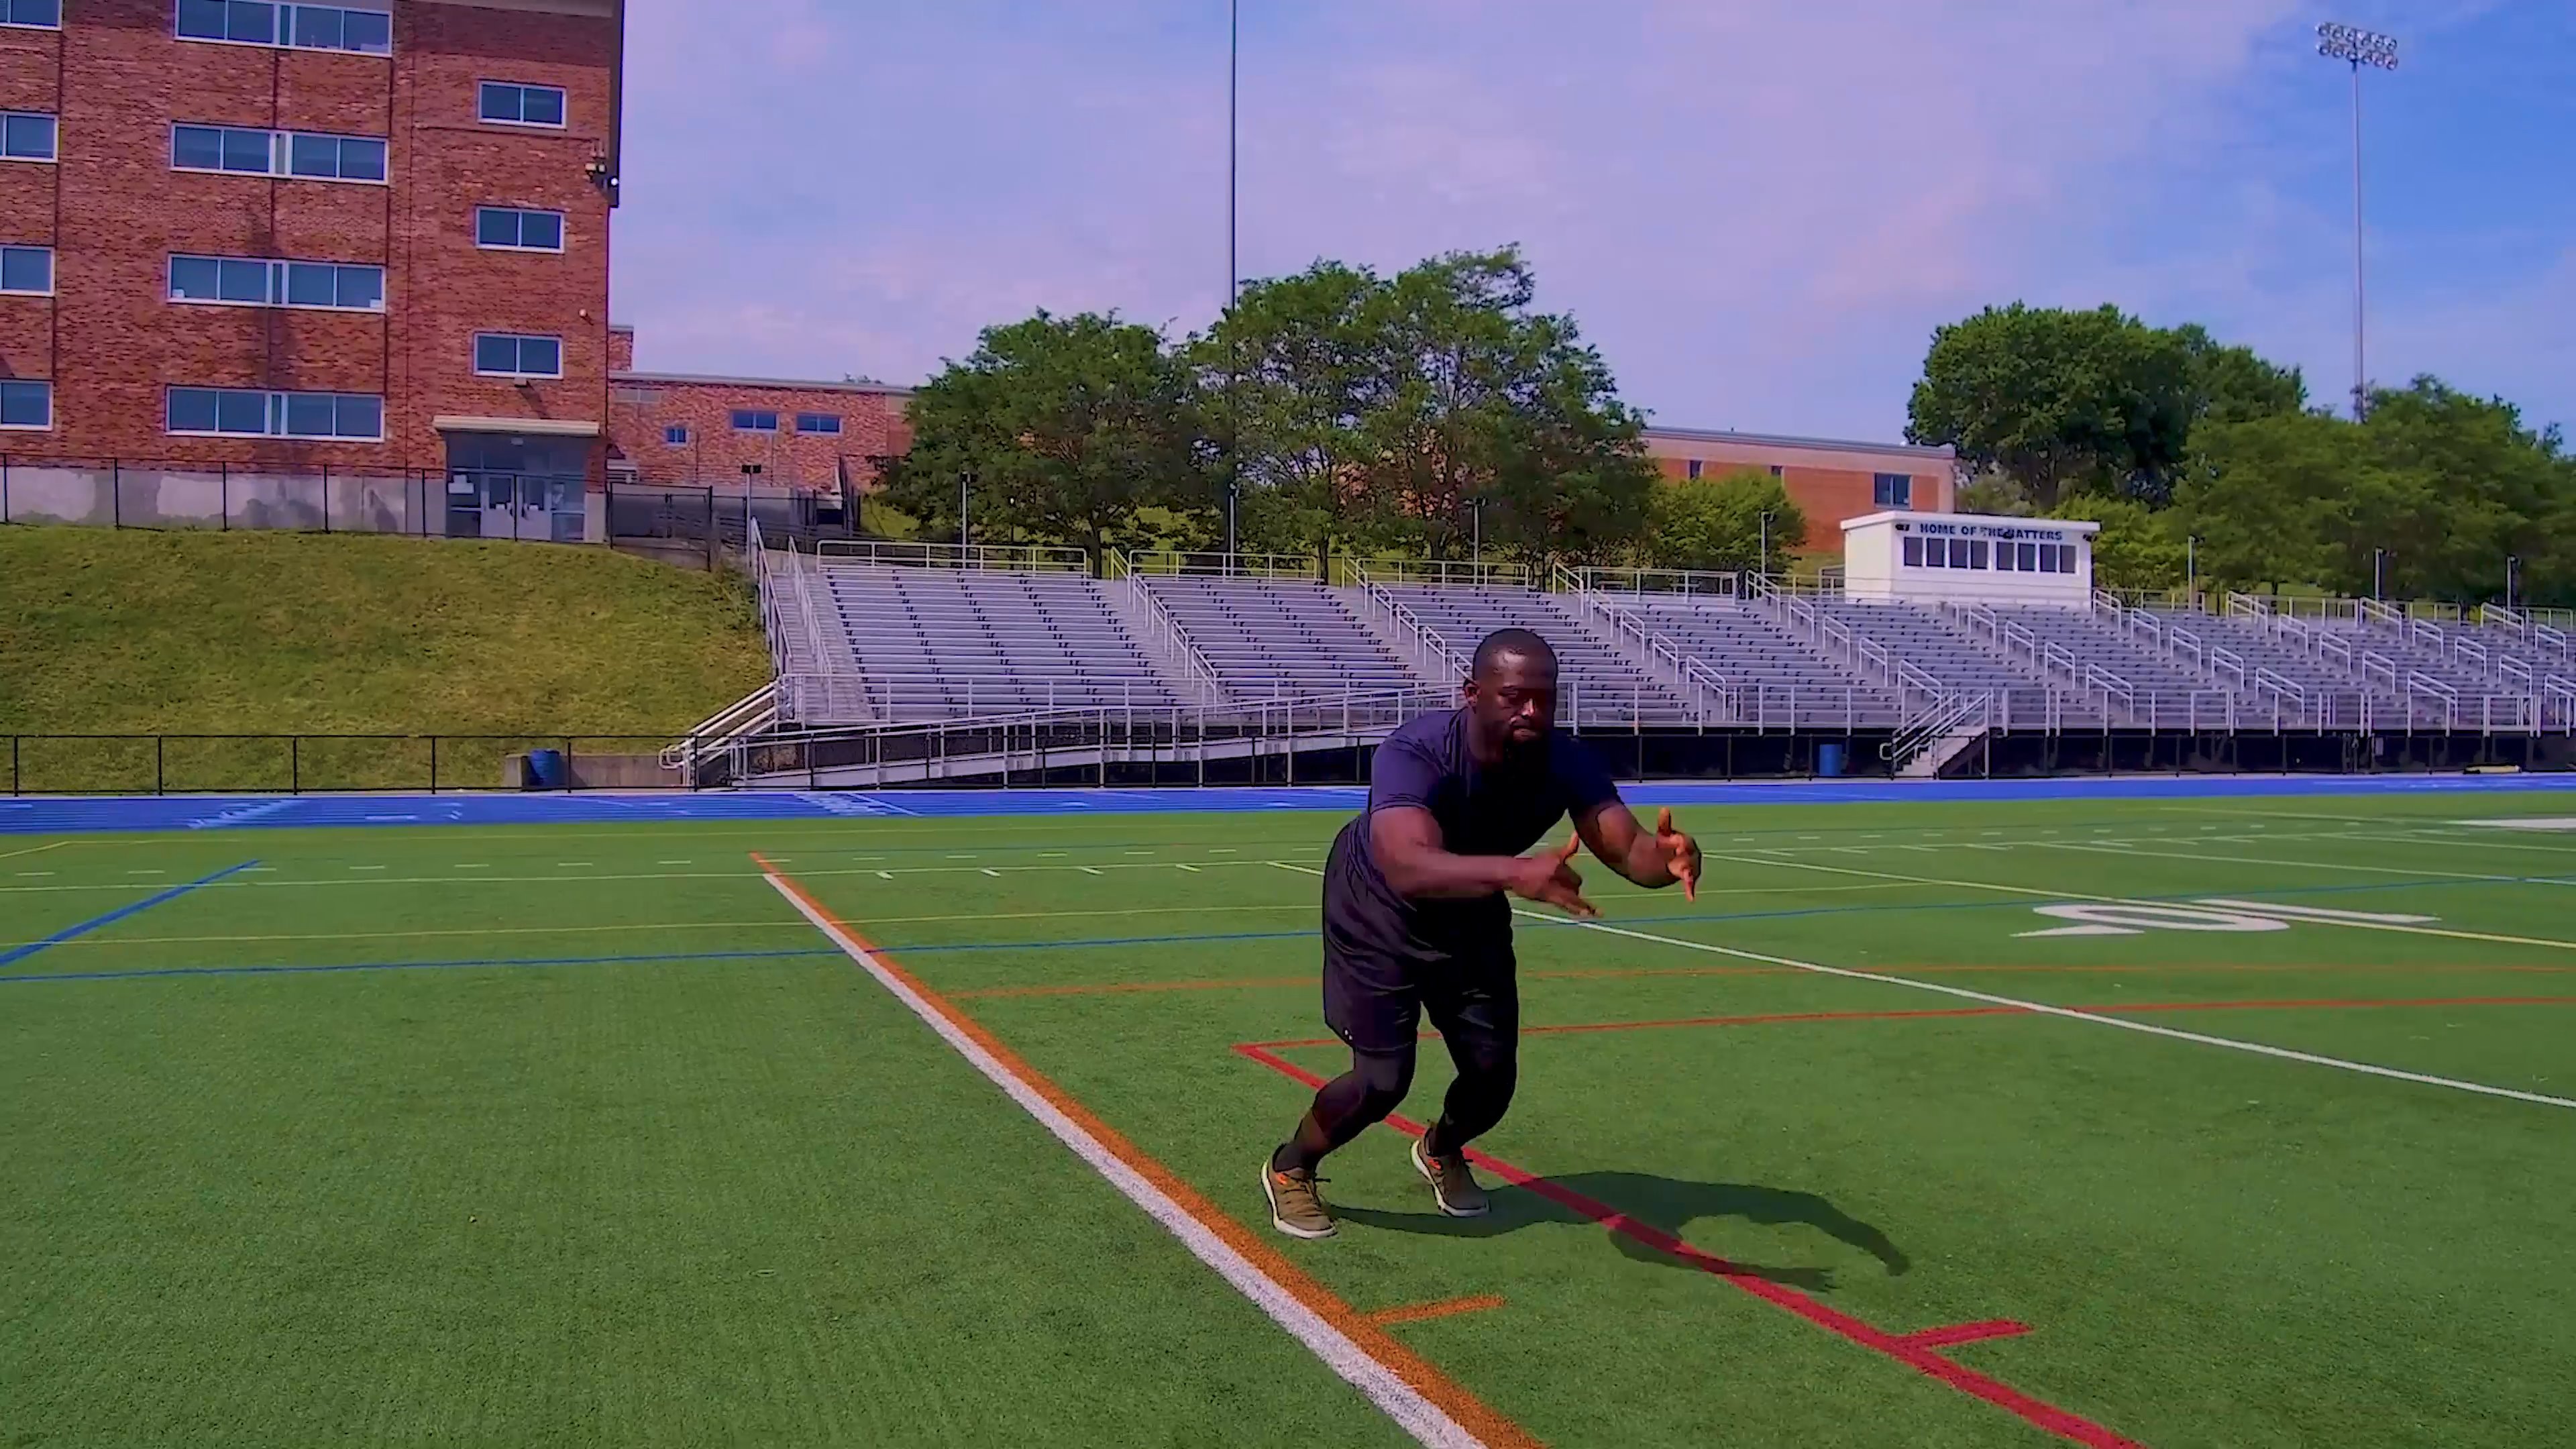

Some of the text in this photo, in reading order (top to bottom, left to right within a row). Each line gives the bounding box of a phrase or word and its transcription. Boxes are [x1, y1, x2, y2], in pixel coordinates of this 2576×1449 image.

[1920, 523, 1955, 535] HOME
[1961, 525, 1977, 535] OF
[1980, 526, 2004, 538] THE
